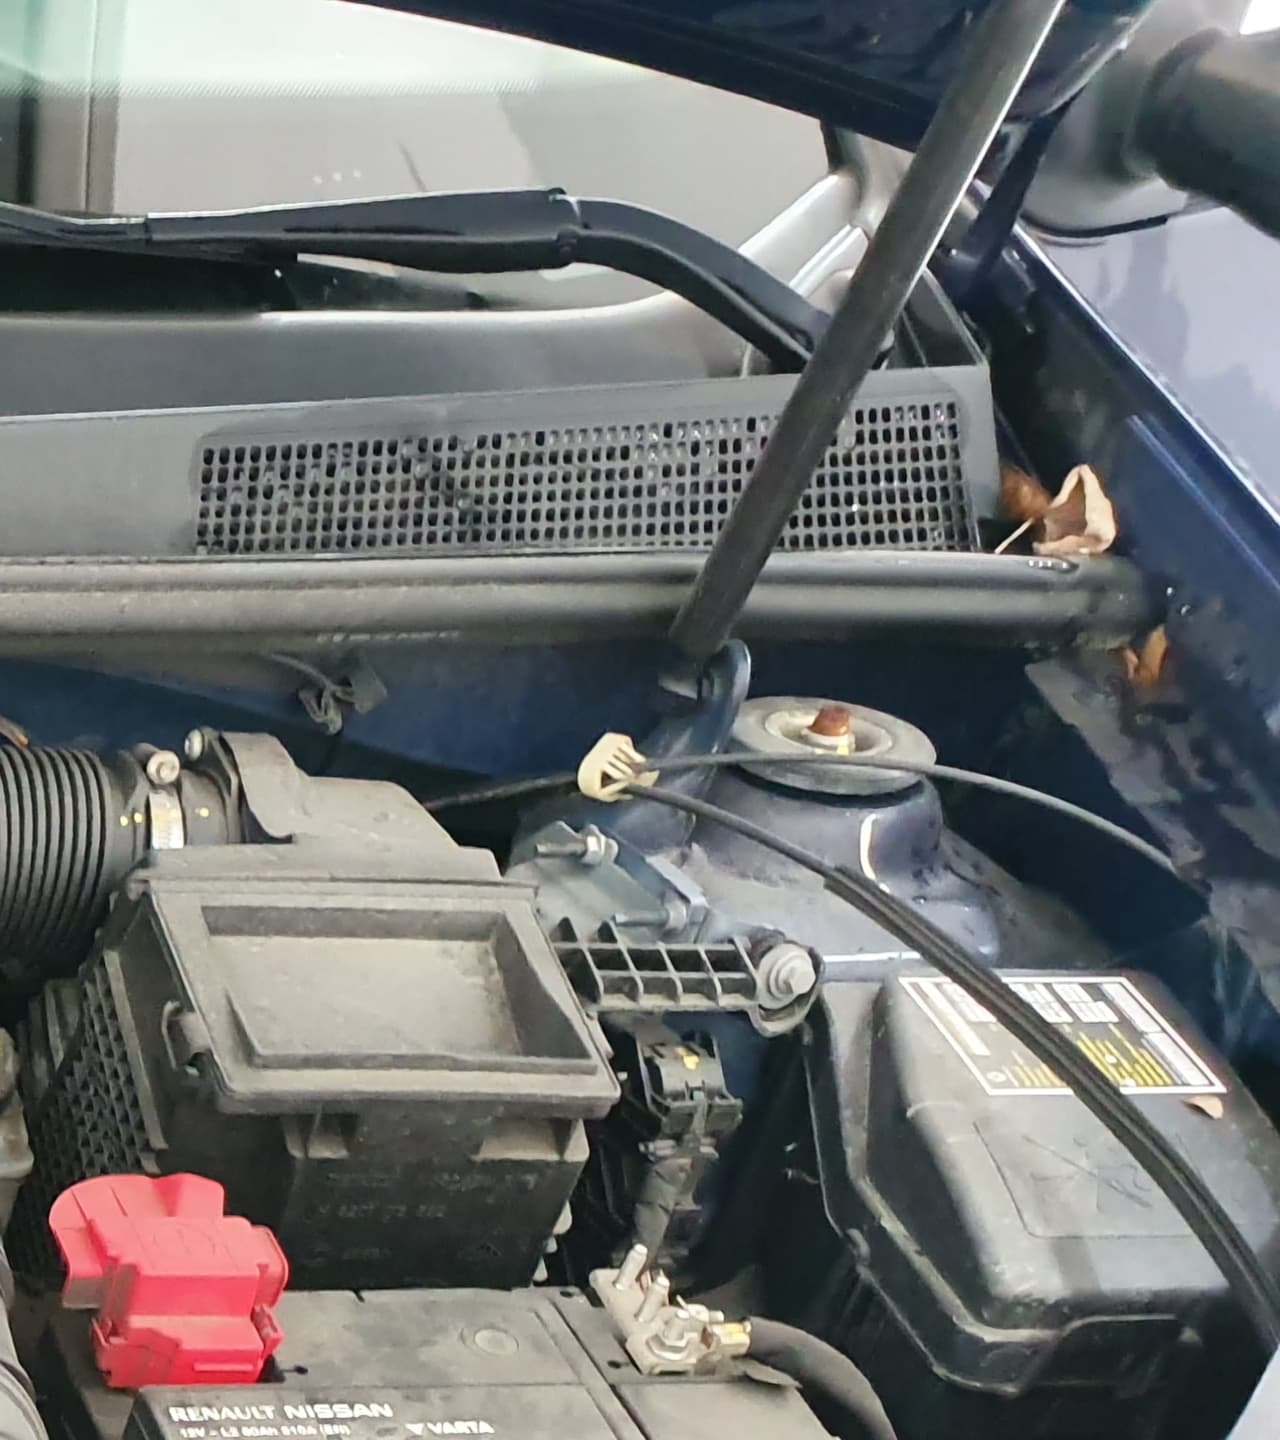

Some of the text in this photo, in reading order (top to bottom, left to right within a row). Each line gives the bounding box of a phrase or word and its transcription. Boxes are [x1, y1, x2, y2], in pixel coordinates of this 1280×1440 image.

[168, 1403, 393, 1422] RENAULT NISSAN
[426, 1420, 495, 1434] VARTA
